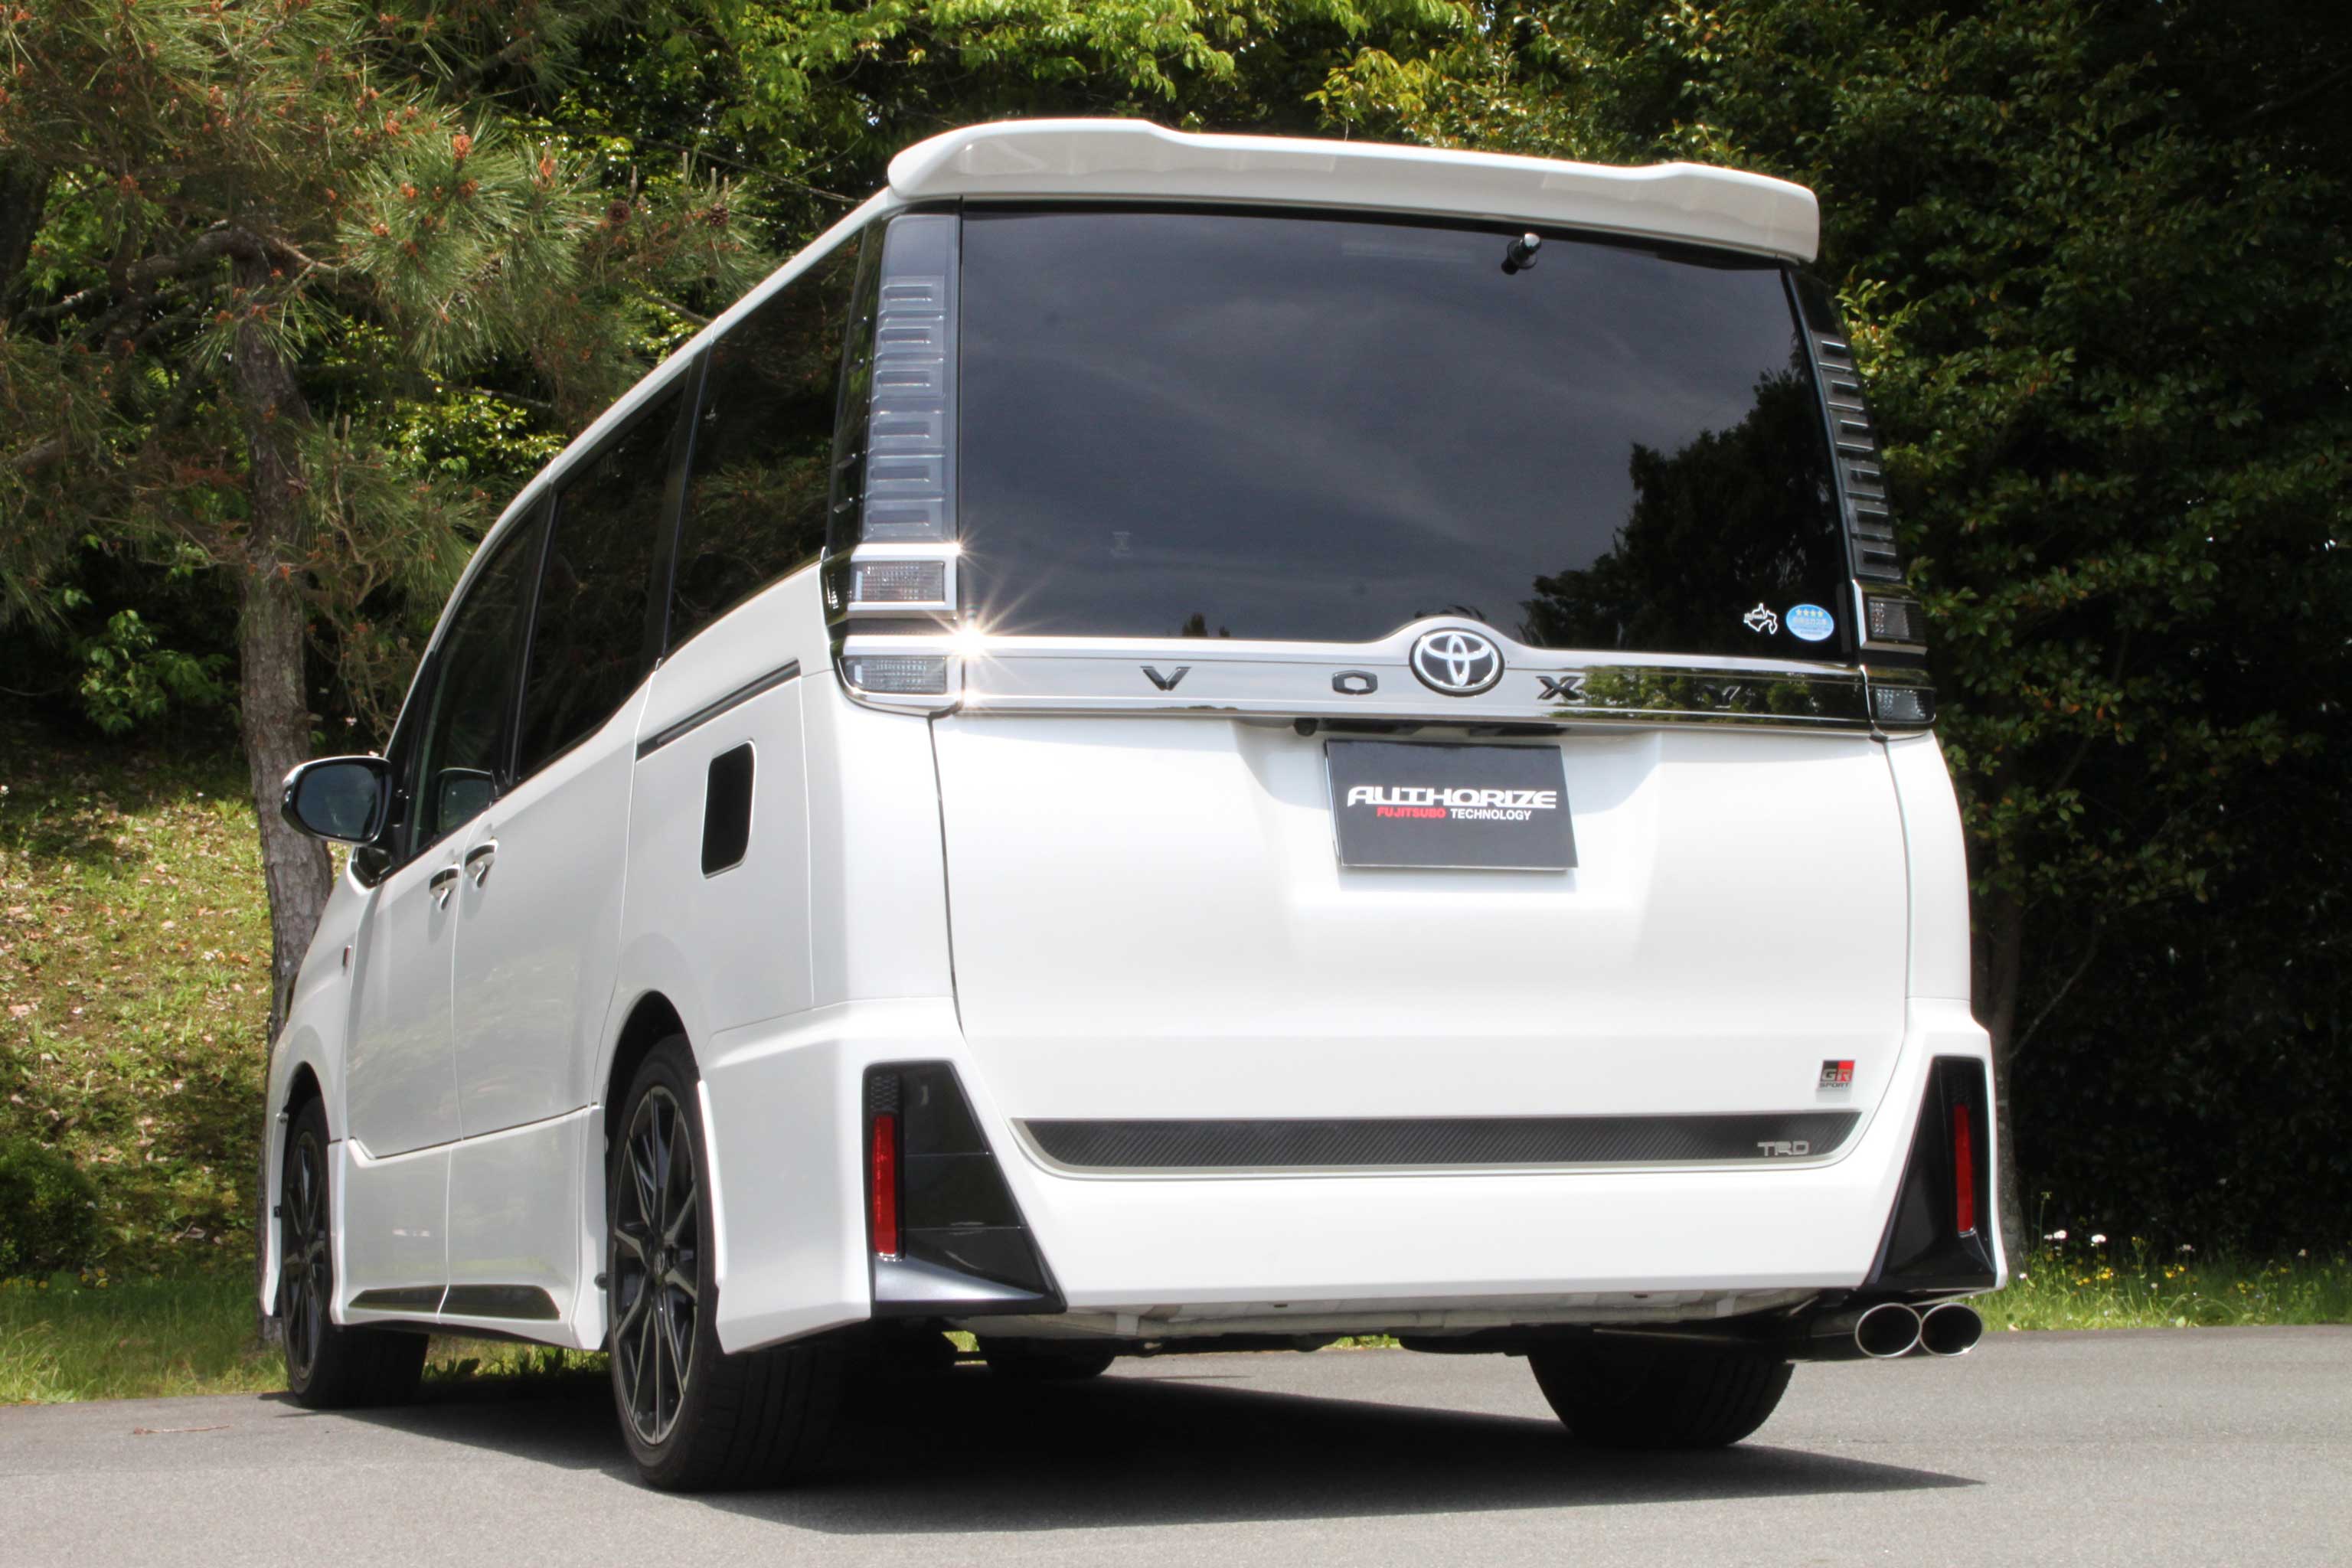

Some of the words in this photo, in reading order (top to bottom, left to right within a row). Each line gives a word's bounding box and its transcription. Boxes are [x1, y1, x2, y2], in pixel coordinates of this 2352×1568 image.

[1347, 786, 1557, 809] AUTHORIZE
[1377, 808, 1446, 819] FUJITSUBO
[1451, 808, 1532, 822] TECHNOLOGY
[1821, 1069, 1851, 1082] GR
[1757, 1141, 1810, 1157] TRD
